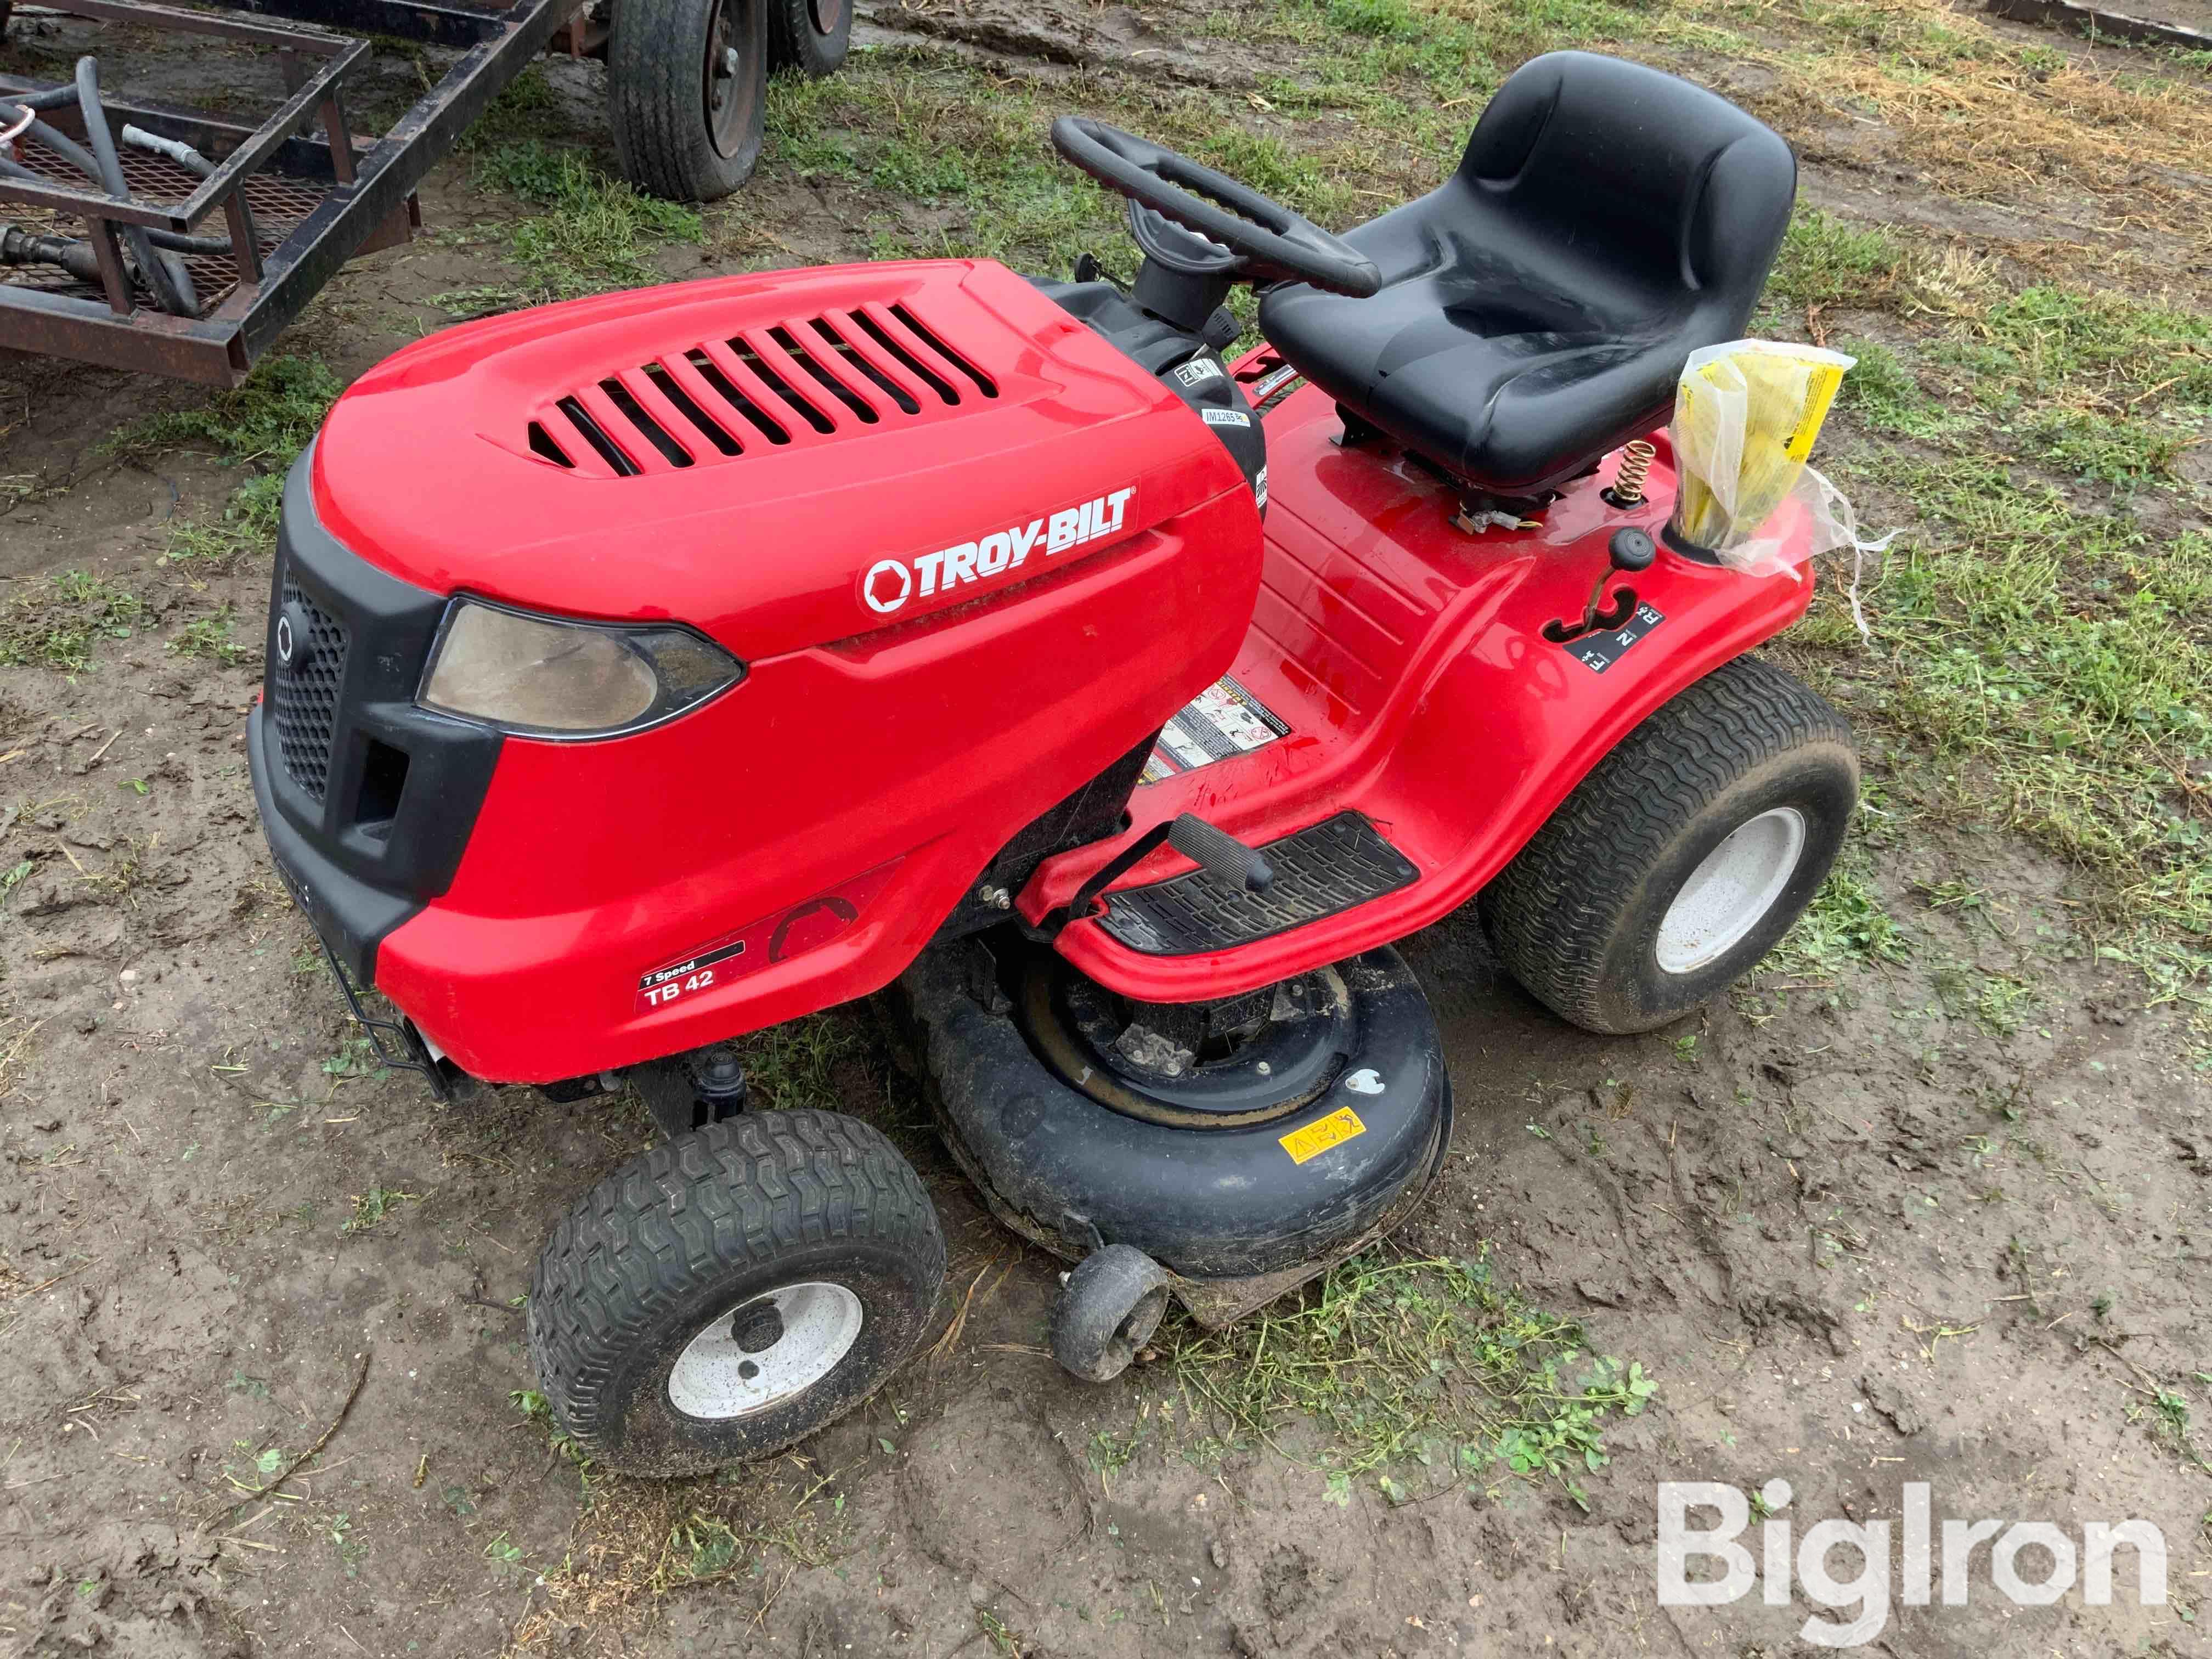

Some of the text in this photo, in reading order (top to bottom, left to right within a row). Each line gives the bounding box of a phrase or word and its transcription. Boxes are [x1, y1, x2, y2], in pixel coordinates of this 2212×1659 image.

[1206, 412, 1235, 421] IM1265
[1643, 611, 1659, 624] R
[1616, 633, 1633, 646] N
[1589, 660, 1605, 670] F
[644, 961, 695, 985] 7 Speed
[644, 970, 713, 1006] TB 42
